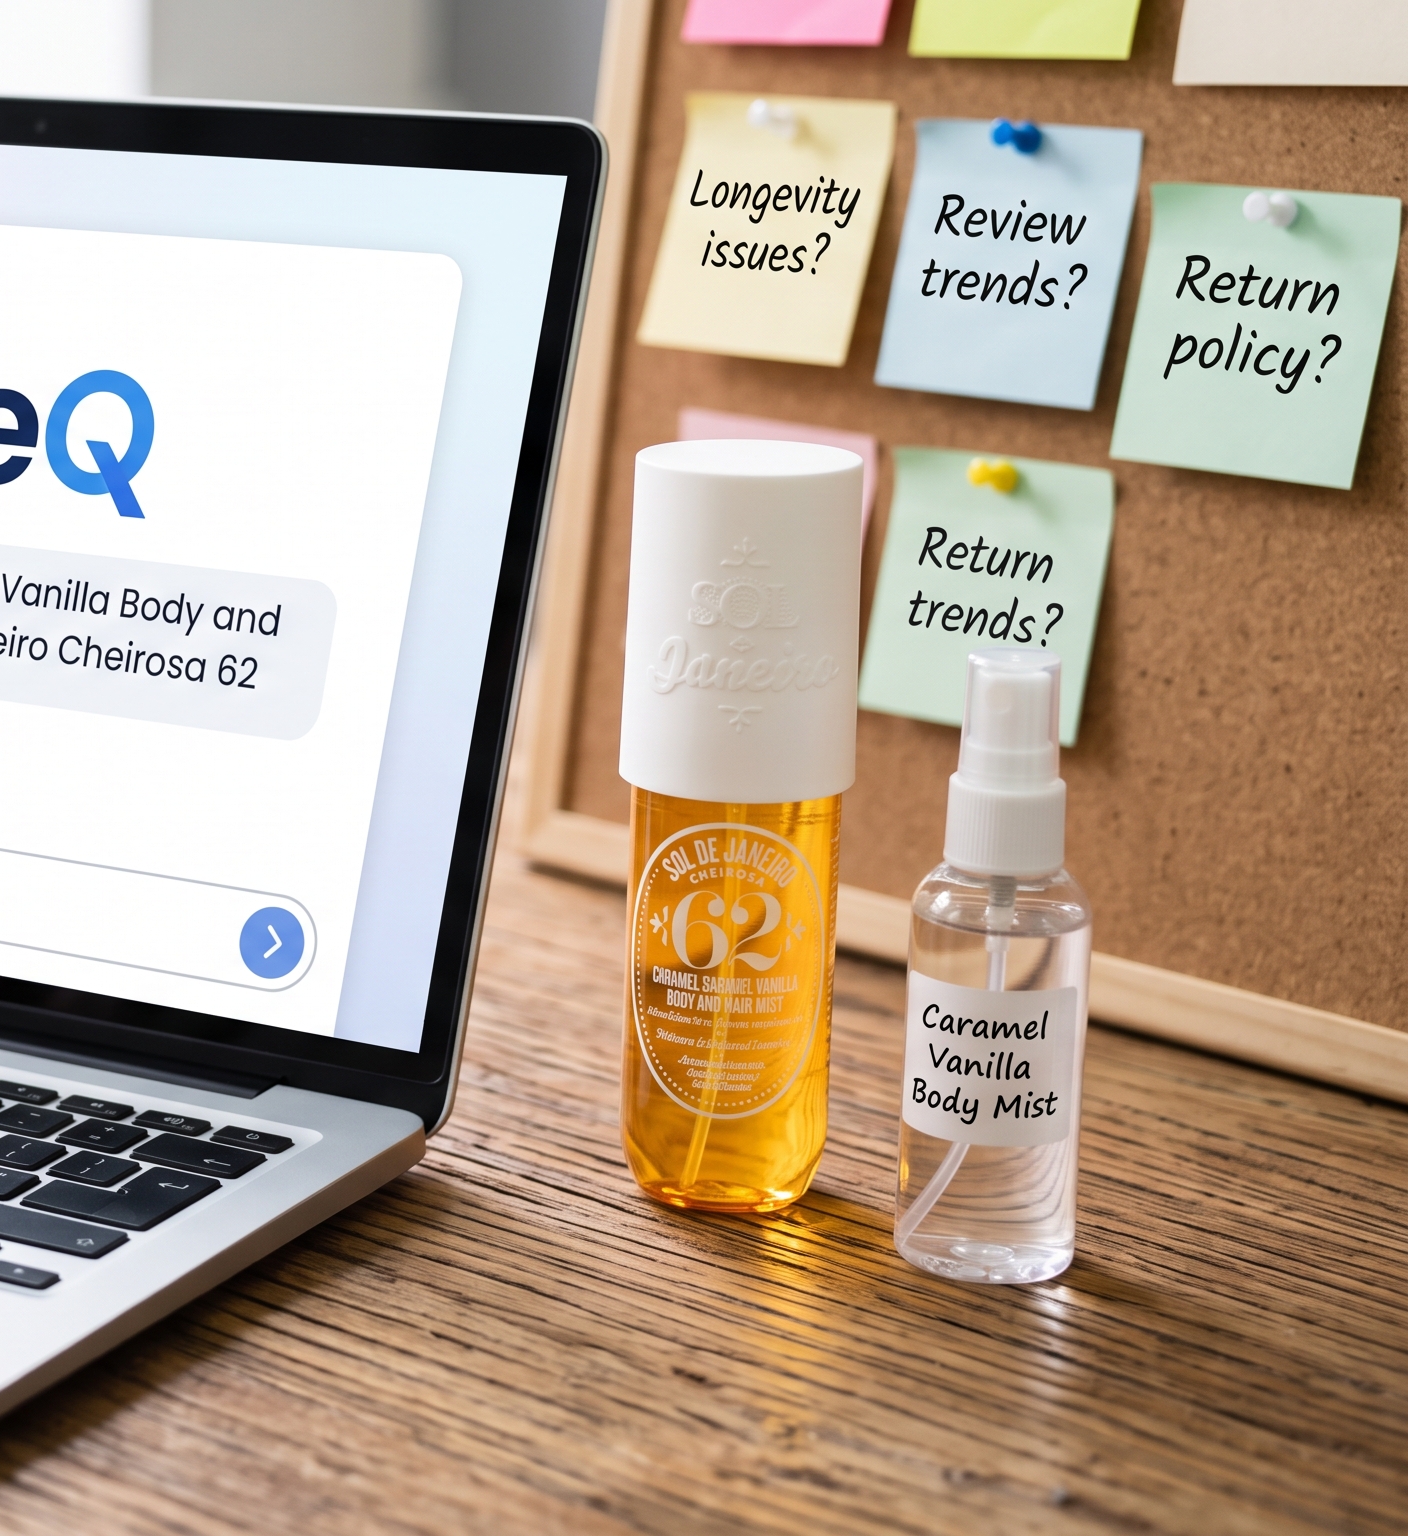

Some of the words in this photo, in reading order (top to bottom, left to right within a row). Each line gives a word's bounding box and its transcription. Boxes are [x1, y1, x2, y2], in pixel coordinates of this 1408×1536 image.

[690, 169, 861, 229] Longevity
[934, 194, 1087, 246] Review
[701, 229, 831, 275] issues?
[921, 258, 1088, 310] trends?
[1175, 254, 1340, 316] Return
[1163, 322, 1342, 395] policy?
[918, 526, 1053, 584] Return
[2, 573, 110, 615] Vanilla
[119, 588, 204, 636] Body
[213, 604, 282, 637] and
[688, 579, 800, 630] SOL
[908, 590, 1064, 647] trends?
[58, 635, 207, 683] Cheirosa
[218, 654, 258, 690] 62
[647, 635, 840, 694] Janeiro
[662, 846, 696, 882] SOL
[694, 837, 720, 866] DE
[723, 837, 799, 888] JANEIRO
[689, 867, 765, 888] CHEIROSA
[672, 890, 782, 971] 62
[652, 965, 700, 992] CARAMEL
[756, 974, 798, 995] VANILLA
[667, 988, 696, 1009] BODY
[697, 994, 721, 1013] AND
[755, 995, 785, 1014] MIST
[922, 1003, 1049, 1041] Caramel
[928, 1042, 1031, 1081] Vanilla
[912, 1077, 980, 1125] Body
[993, 1091, 1059, 1119] Mist
